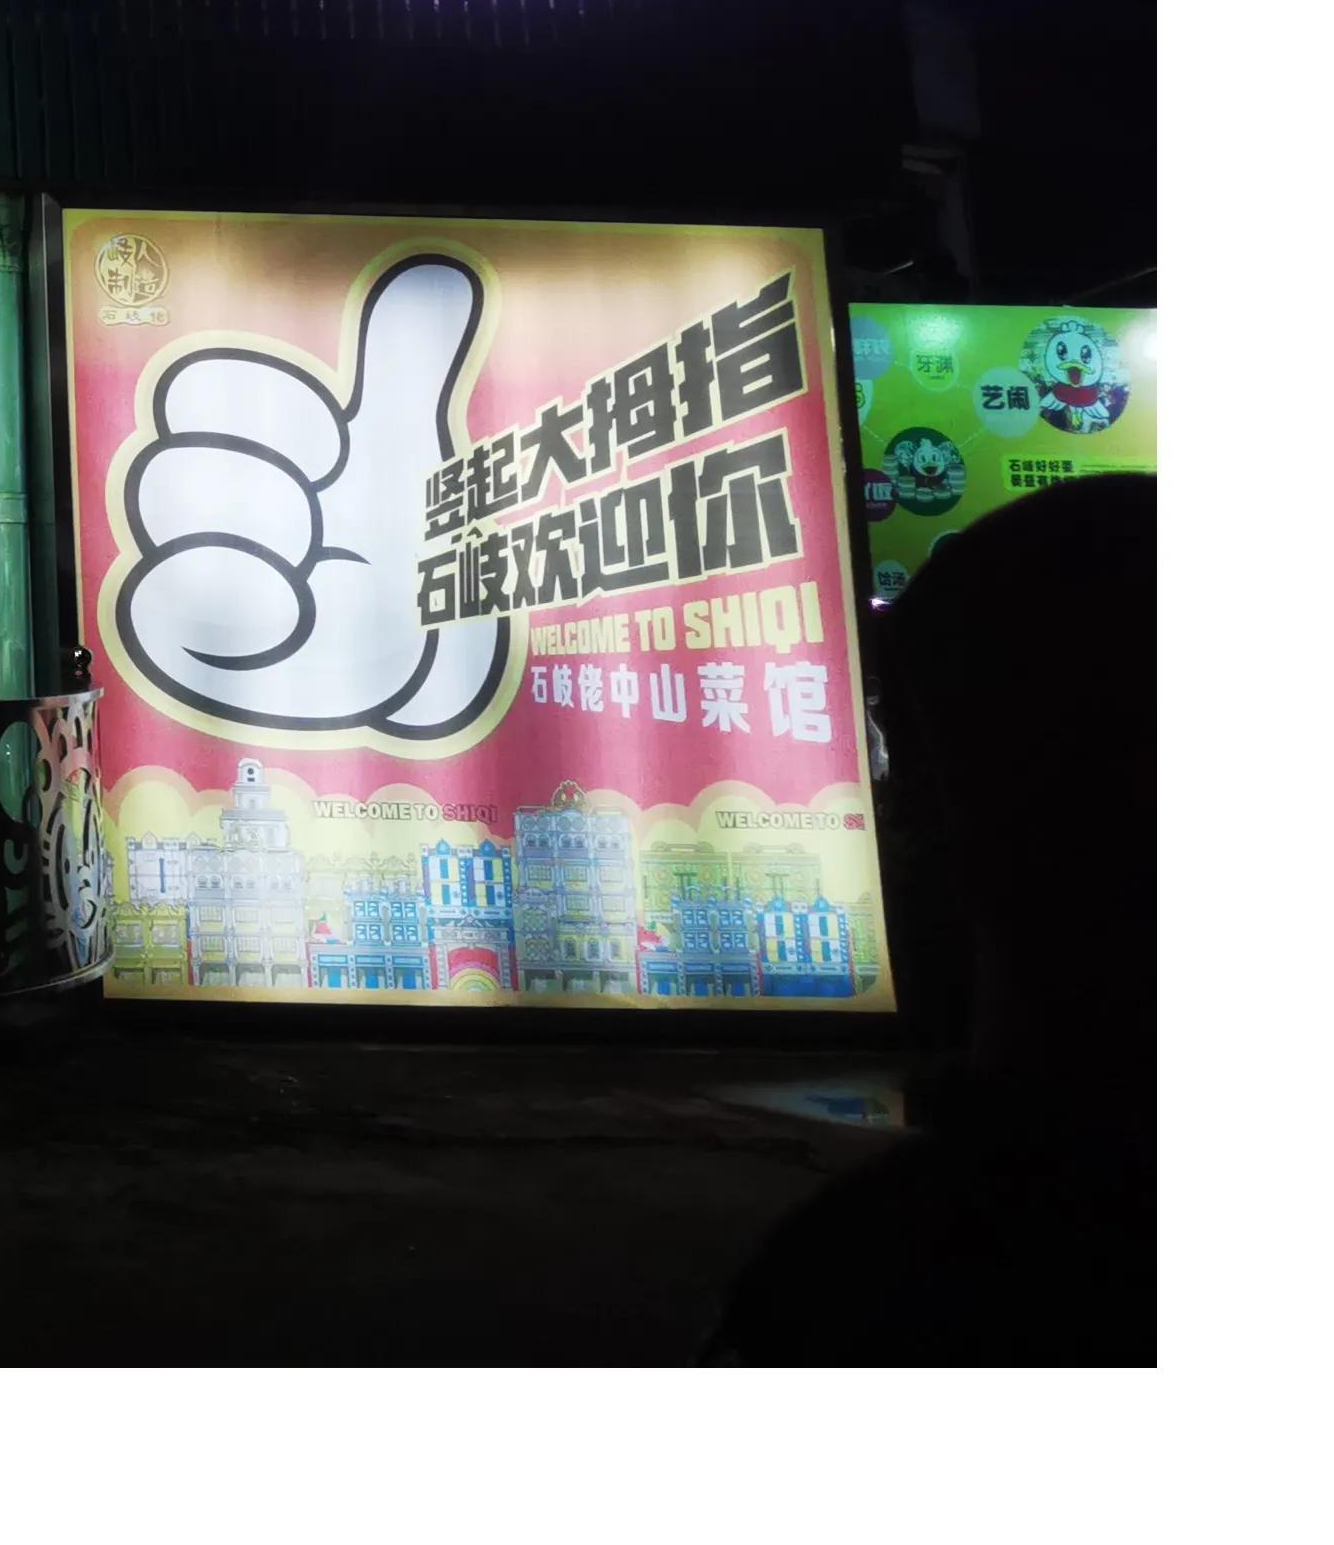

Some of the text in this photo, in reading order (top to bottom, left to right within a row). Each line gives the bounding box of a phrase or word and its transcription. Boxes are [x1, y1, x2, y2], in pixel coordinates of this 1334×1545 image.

[425, 272, 804, 540] 竖起大拇指
[418, 433, 799, 625] 石岐欢迎你
[531, 581, 825, 655] WELCOME TO SHIQI
[531, 660, 832, 743] 石岐佬中山菜馆
[313, 800, 499, 824] WELCOME TO SHIQI
[716, 810, 813, 830] WELCOME
[814, 812, 840, 830] TO
